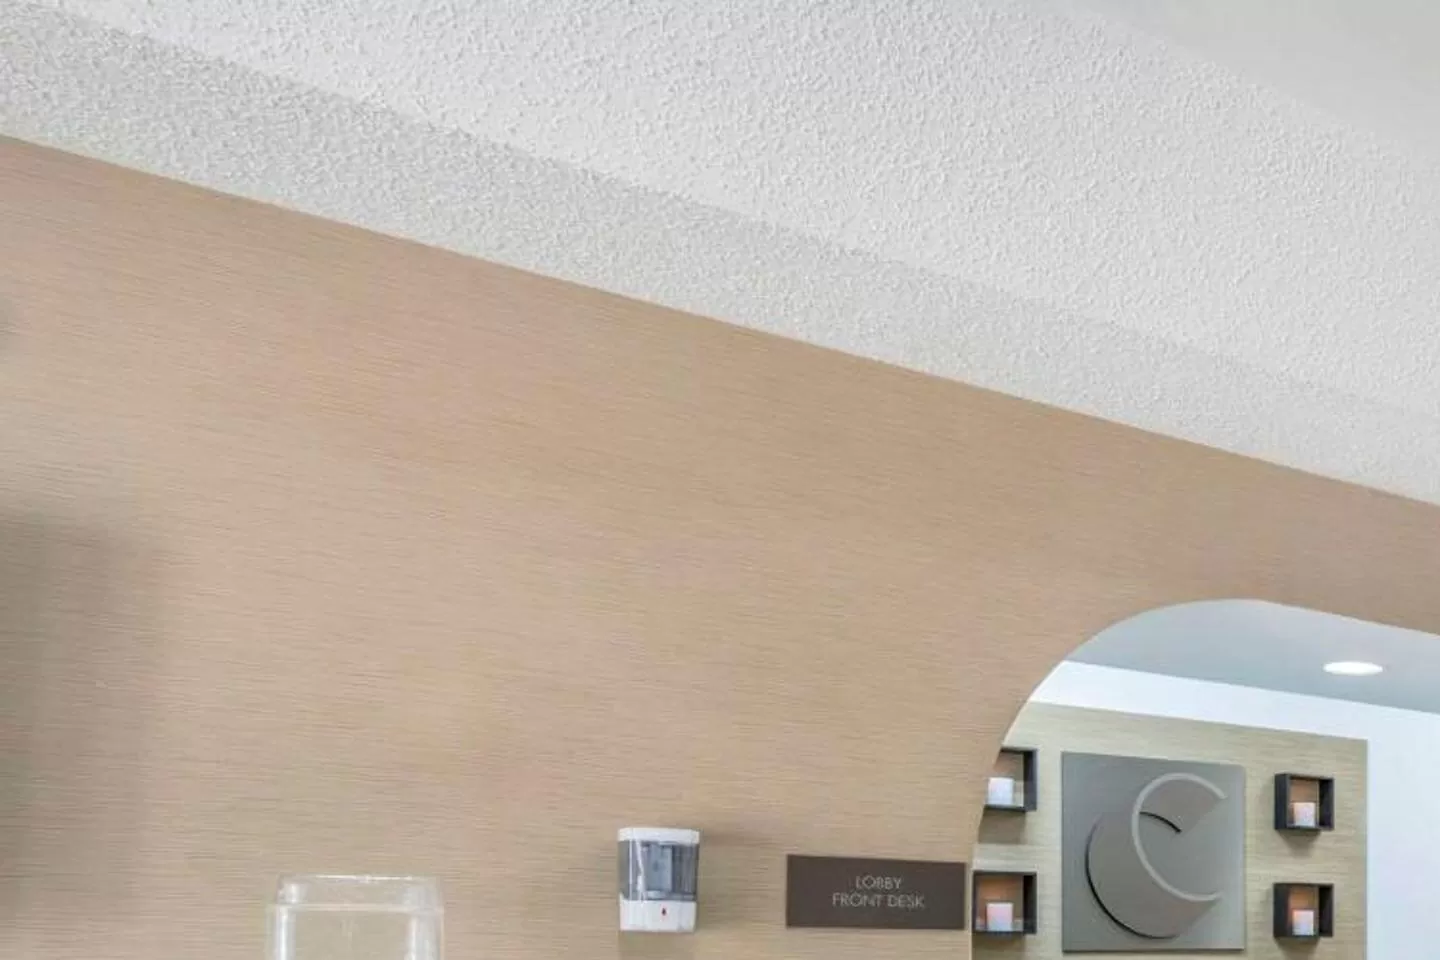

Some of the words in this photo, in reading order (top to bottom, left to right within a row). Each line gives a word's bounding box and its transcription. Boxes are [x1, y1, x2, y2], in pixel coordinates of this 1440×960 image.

[856, 875, 901, 890] LOBBY
[832, 892, 884, 908] FRONT
[887, 894, 924, 909] DESK
